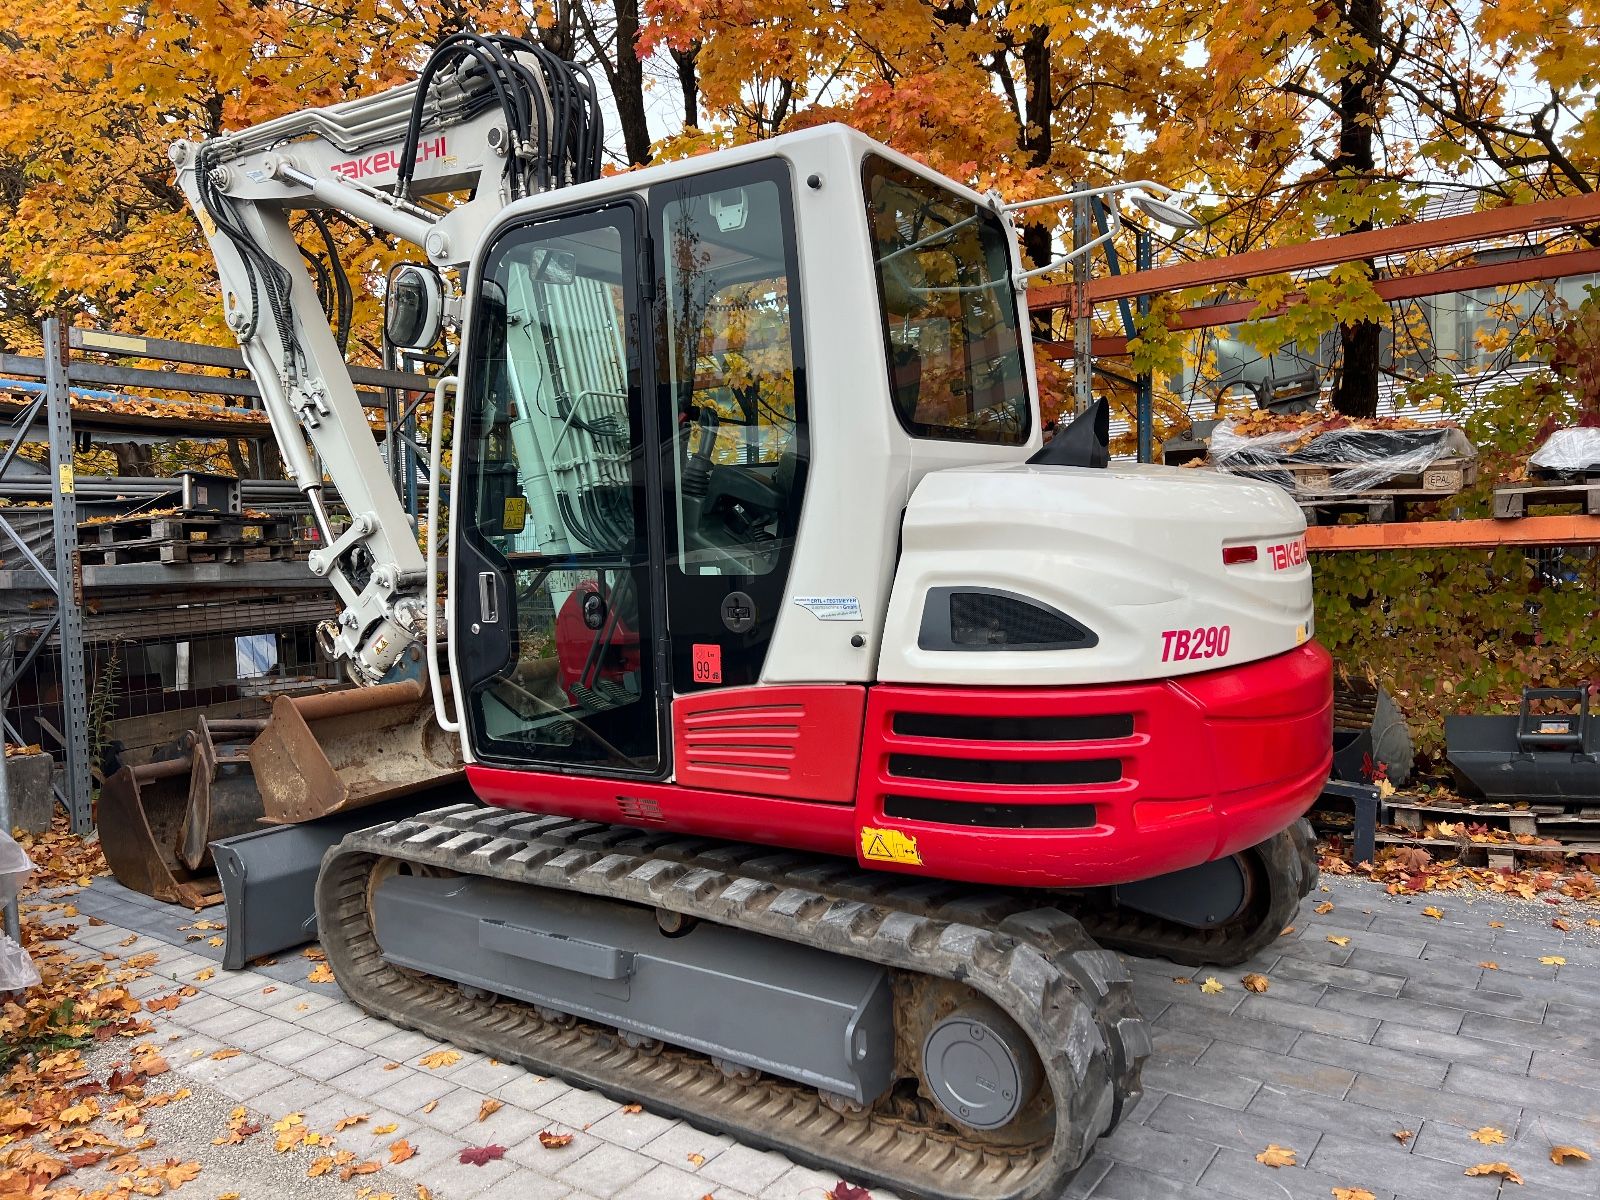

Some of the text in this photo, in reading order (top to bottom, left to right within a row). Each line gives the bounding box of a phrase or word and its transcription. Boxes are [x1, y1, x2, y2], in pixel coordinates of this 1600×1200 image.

[1430, 475, 1450, 484] EPAL
[1161, 625, 1231, 662] TB290
[697, 661, 710, 679] 99
